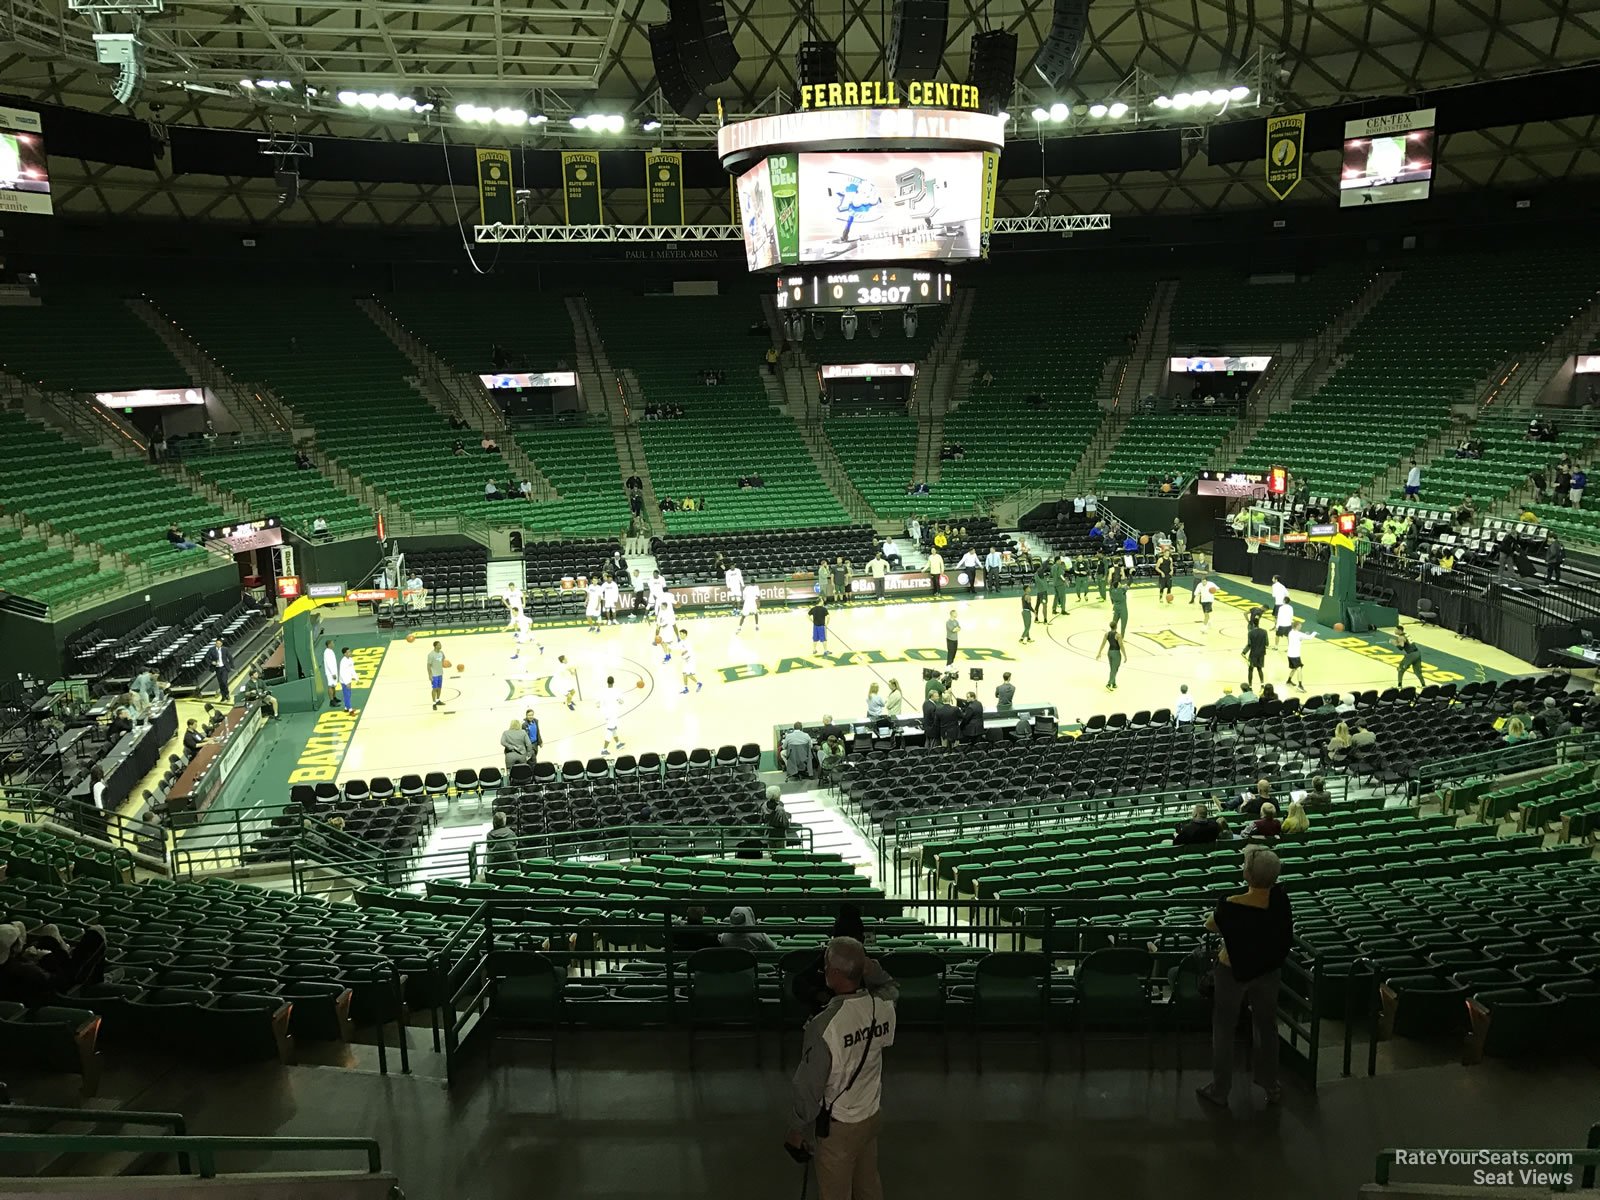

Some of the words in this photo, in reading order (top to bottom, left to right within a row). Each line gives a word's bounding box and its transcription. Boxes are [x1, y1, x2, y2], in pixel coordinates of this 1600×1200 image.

[802, 82, 900, 108] FERRELL
[908, 81, 980, 109] CENTER
[1270, 119, 1302, 132] BAYLOR
[1366, 113, 1412, 129] CEN-TEX
[479, 152, 509, 163] BAYLOR
[565, 154, 597, 165] BAYLOR
[648, 156, 680, 166] BAYLOR
[770, 156, 788, 169] DO
[771, 172, 797, 186] DEW
[983, 156, 994, 247] BAYLOR
[625, 250, 647, 259] PAUL
[656, 249, 687, 259] MEYER
[688, 249, 719, 258] ARENA
[872, 273, 880, 282] 4
[889, 273, 897, 281] 4
[833, 285, 844, 299] 0
[857, 286, 911, 304] 38:07
[920, 282, 929, 297] 0
[675, 592, 689, 605] to
[692, 589, 710, 604] the
[718, 647, 1017, 683] BAYLOR
[1326, 636, 1466, 683] BEARS
[288, 709, 361, 784] BAYLOR
